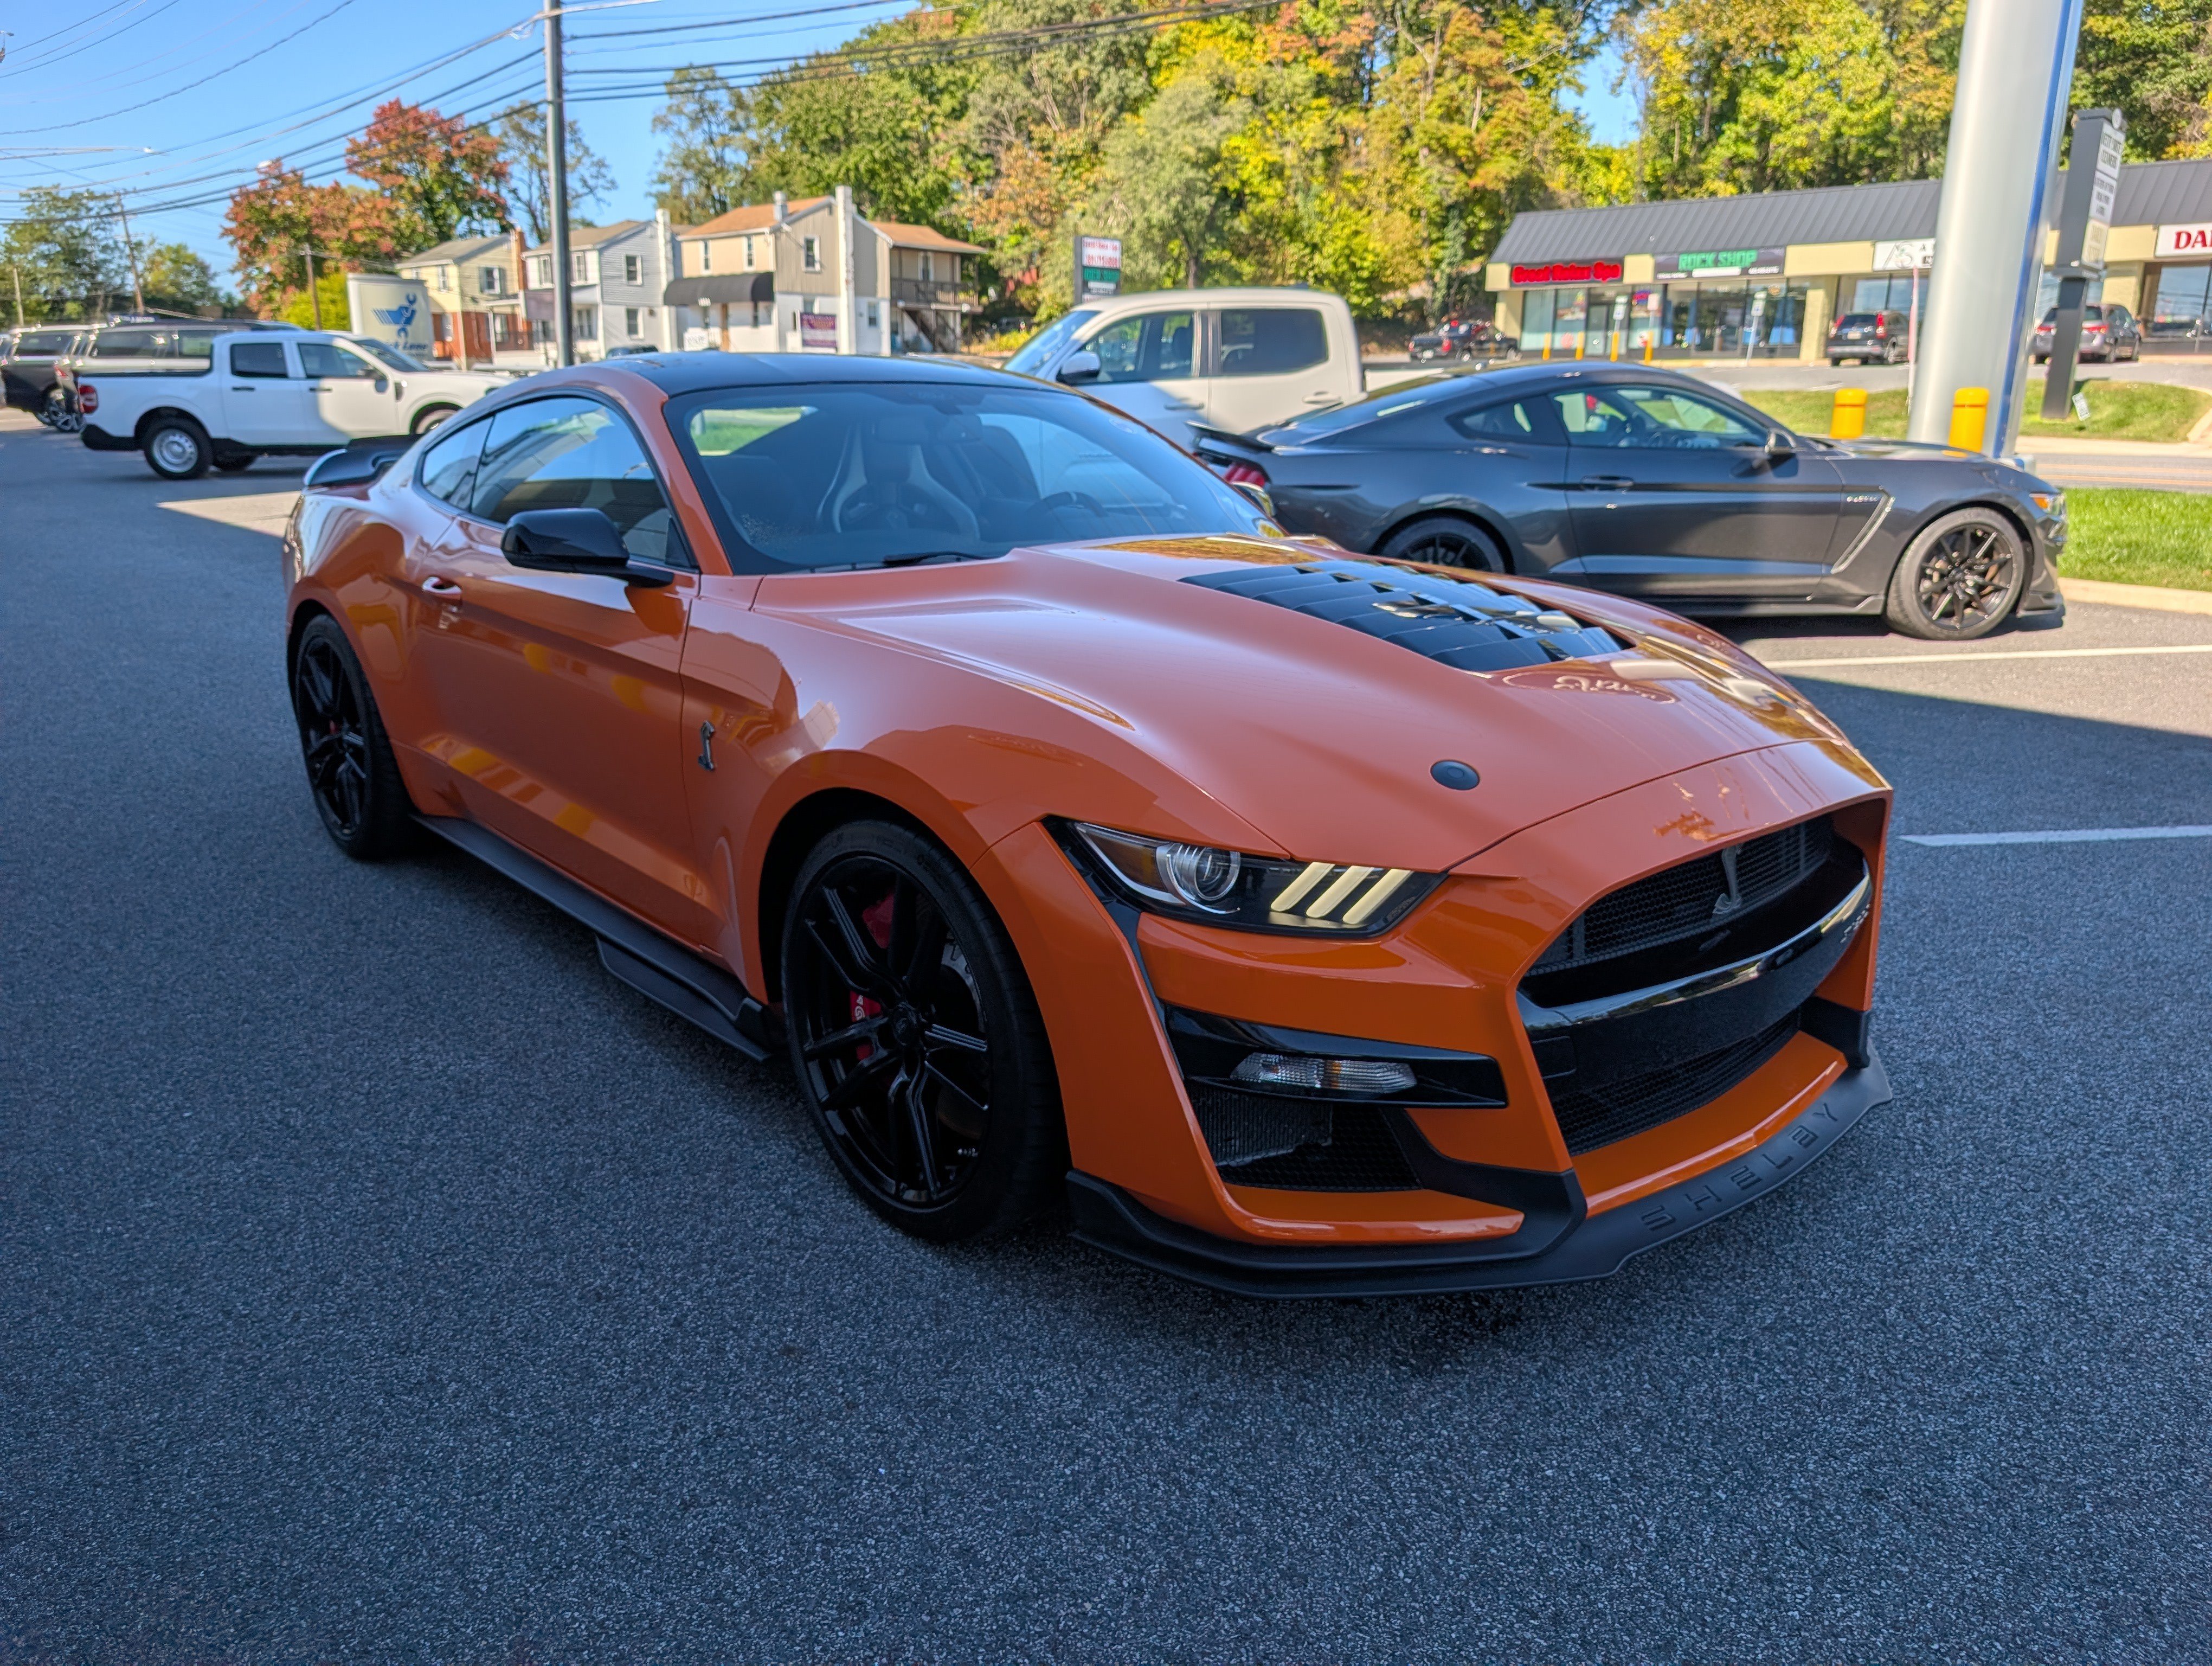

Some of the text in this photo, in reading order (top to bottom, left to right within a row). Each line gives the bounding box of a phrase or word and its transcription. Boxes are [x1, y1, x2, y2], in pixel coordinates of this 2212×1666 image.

[2174, 230, 2212, 249] DA
[1678, 249, 1758, 271] ROCK SHOP
[1593, 261, 1621, 284] Spa
[1641, 1103, 1838, 1232] SHELBY
